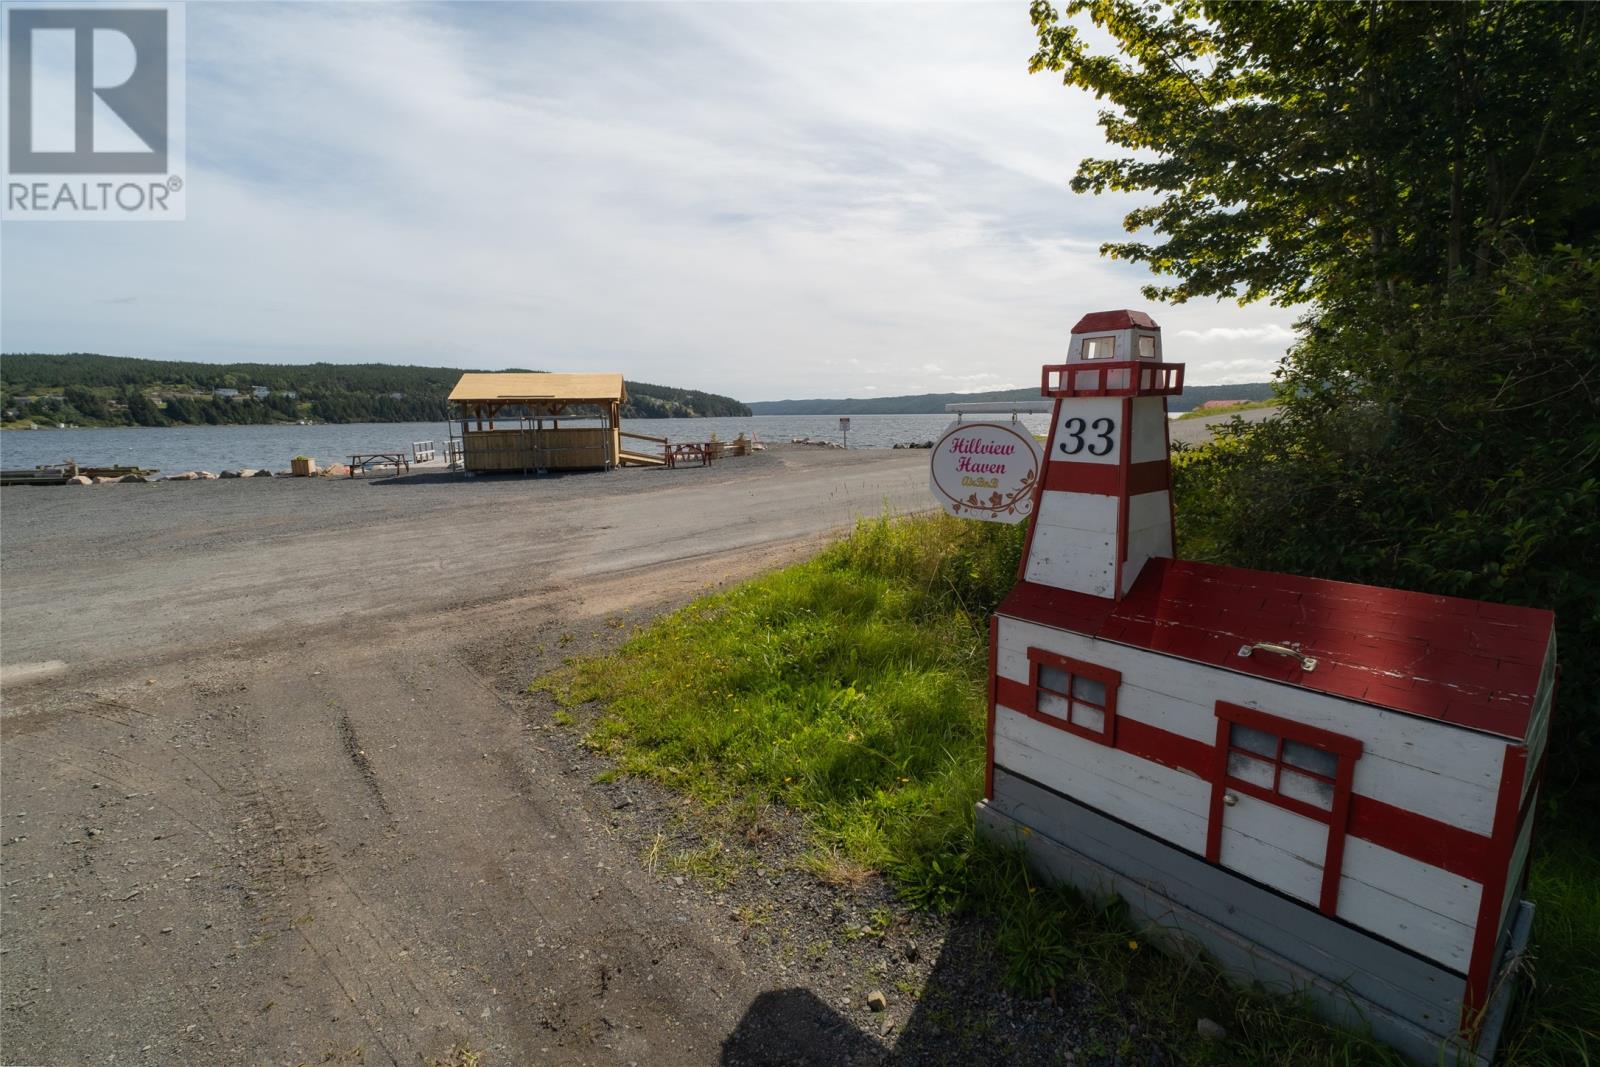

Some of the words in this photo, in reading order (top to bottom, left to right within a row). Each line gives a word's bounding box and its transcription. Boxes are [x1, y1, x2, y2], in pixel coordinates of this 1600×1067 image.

[1059, 417, 1115, 456] 33
[949, 437, 1015, 456] Hillview
[956, 456, 1007, 474] Haven
